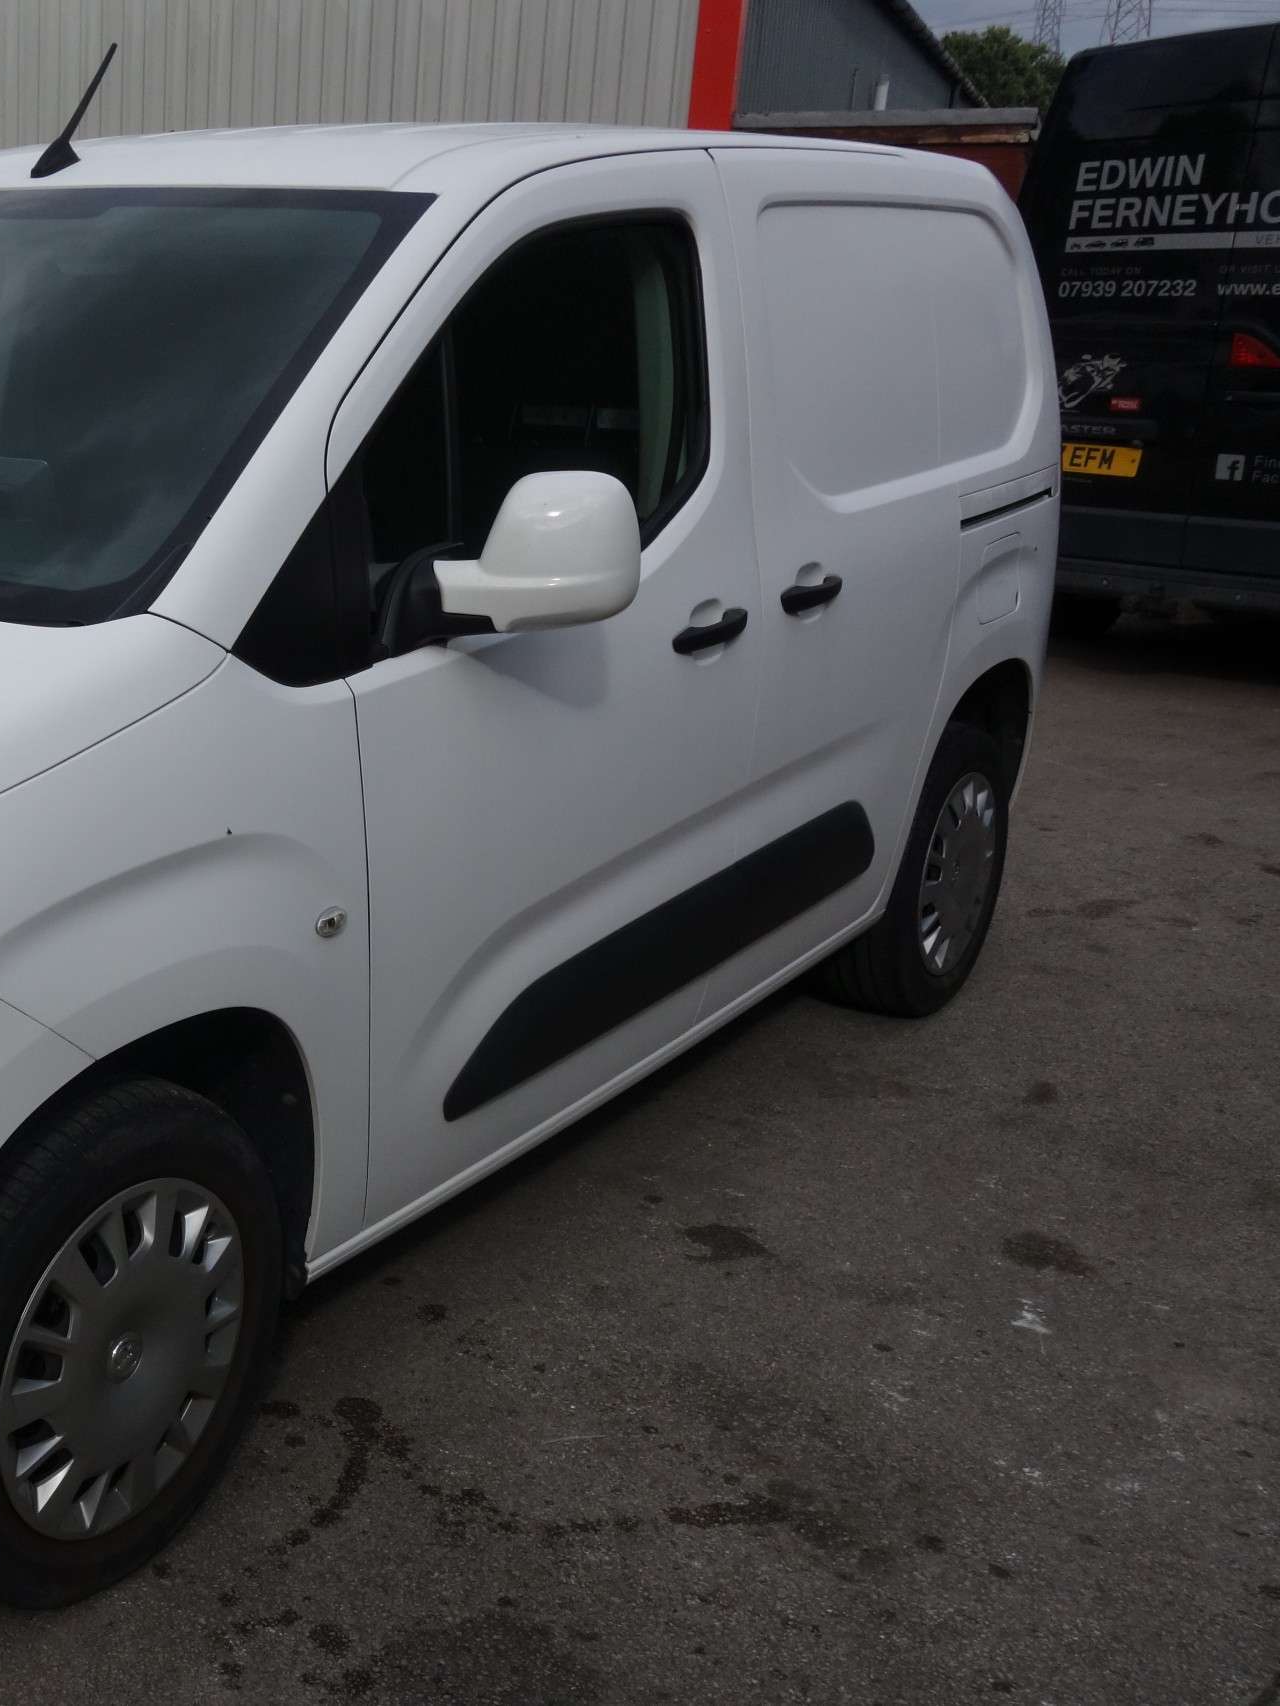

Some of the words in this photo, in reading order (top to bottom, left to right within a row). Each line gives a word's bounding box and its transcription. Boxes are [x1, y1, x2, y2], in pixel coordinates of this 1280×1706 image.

[1075, 154, 1206, 192] EDWIN
[1240, 264, 1272, 274] VISIT
[1058, 281, 1116, 298] 07939
[1121, 279, 1197, 297] 207232
[1069, 446, 1116, 470] EFM
[1254, 455, 1280, 468] Fin
